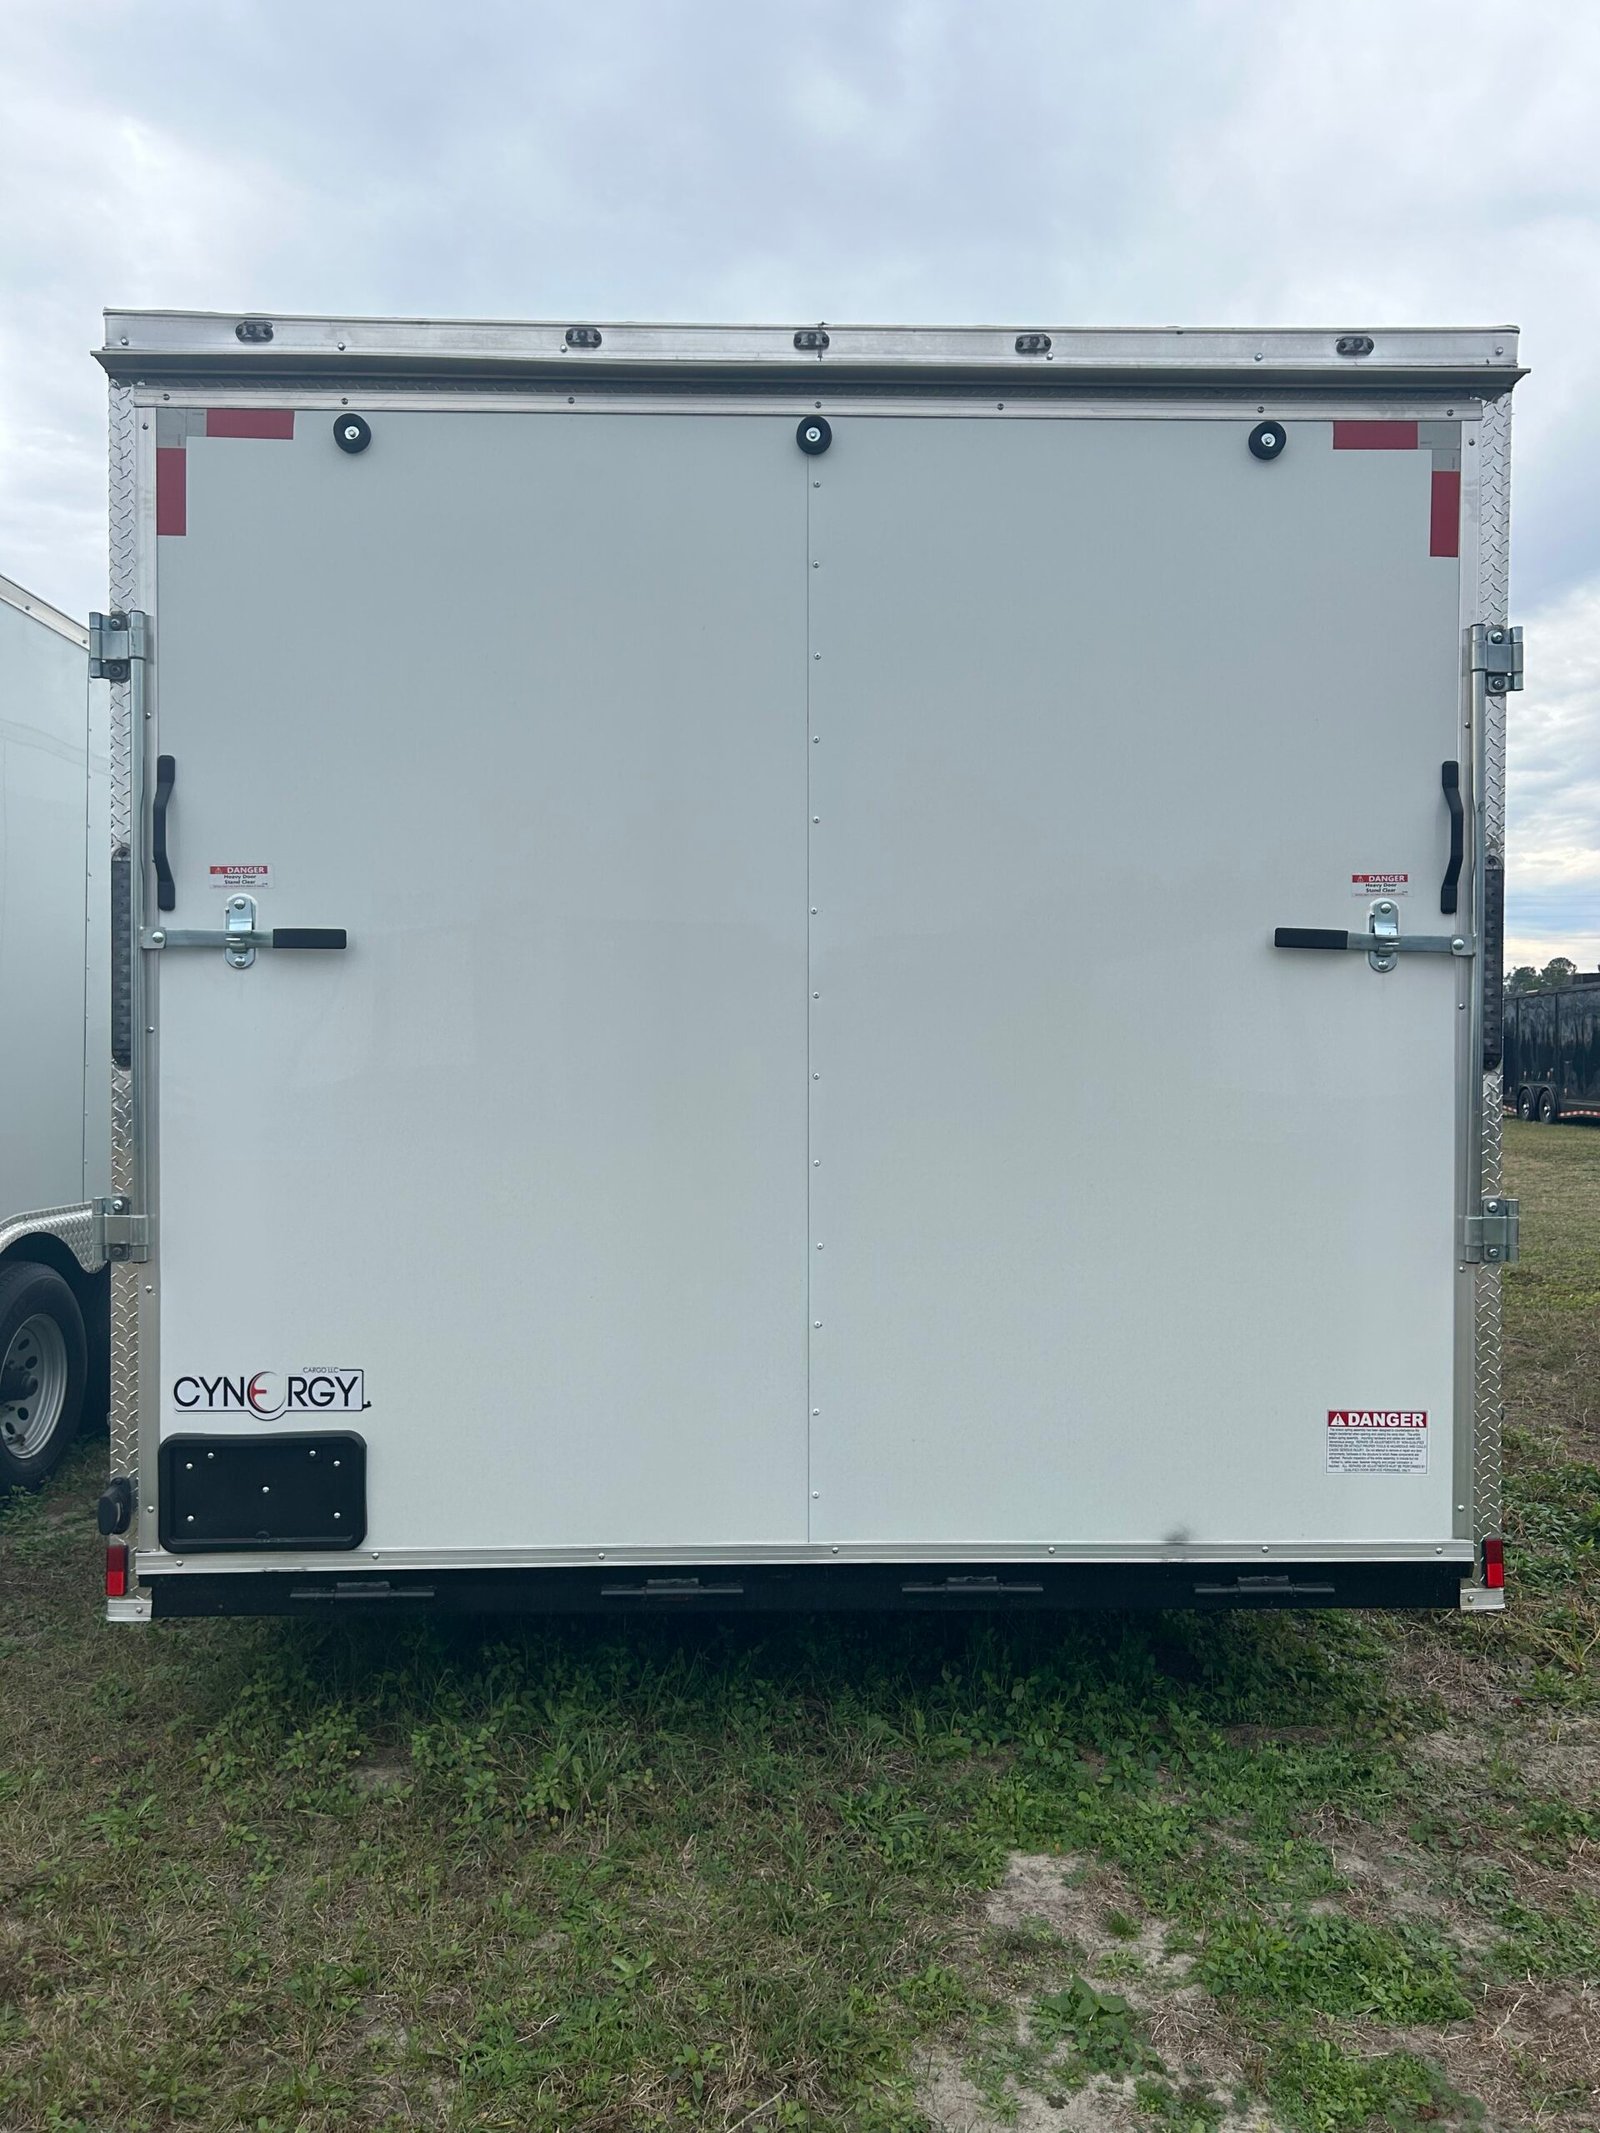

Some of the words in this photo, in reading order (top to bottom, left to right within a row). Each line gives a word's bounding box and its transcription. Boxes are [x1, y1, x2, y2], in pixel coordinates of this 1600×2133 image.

[302, 1366, 327, 1374] CARGO
[327, 1366, 340, 1374] LLC
[173, 1371, 359, 1414] CYNERGY
[1347, 1412, 1425, 1427] DANGER
